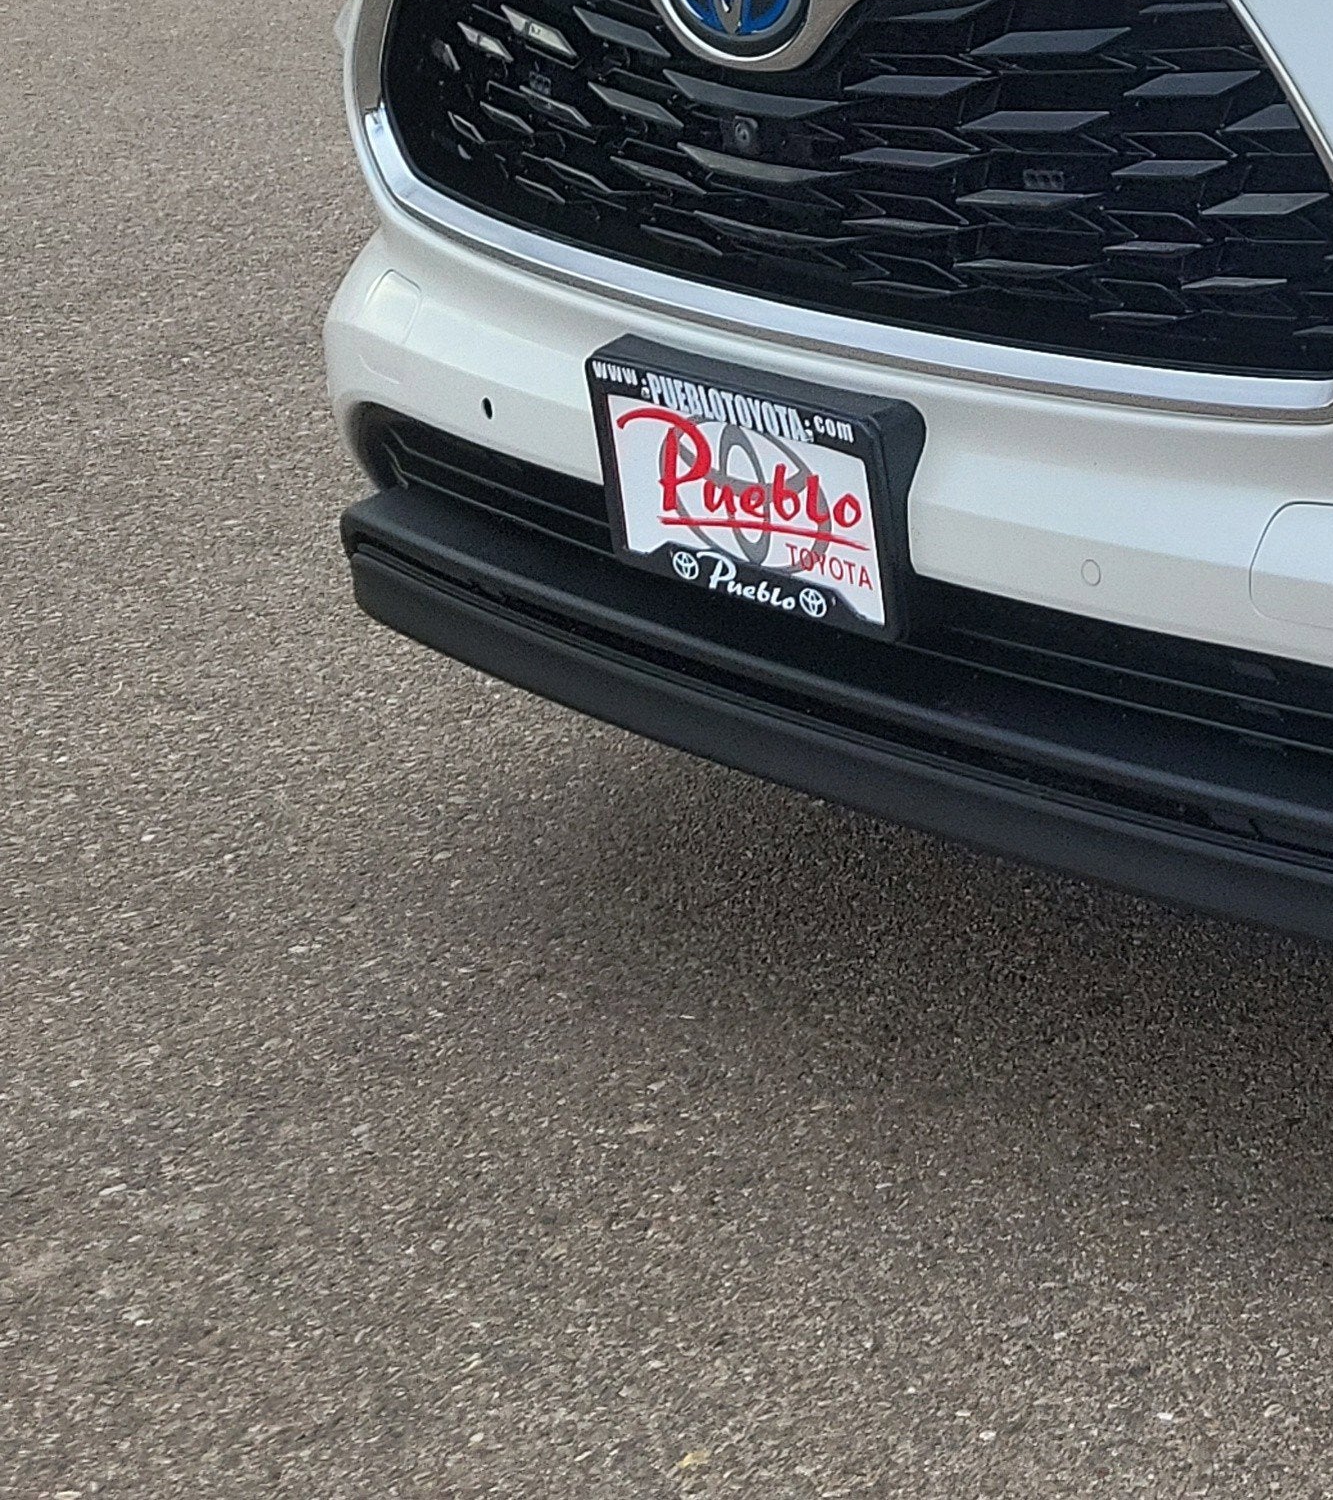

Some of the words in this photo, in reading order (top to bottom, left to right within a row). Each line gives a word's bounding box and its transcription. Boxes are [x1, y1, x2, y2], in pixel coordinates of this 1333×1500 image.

[616, 406, 863, 528] Pueblo
[696, 551, 797, 611] Pueblo
[784, 542, 874, 591] TOYOTA
